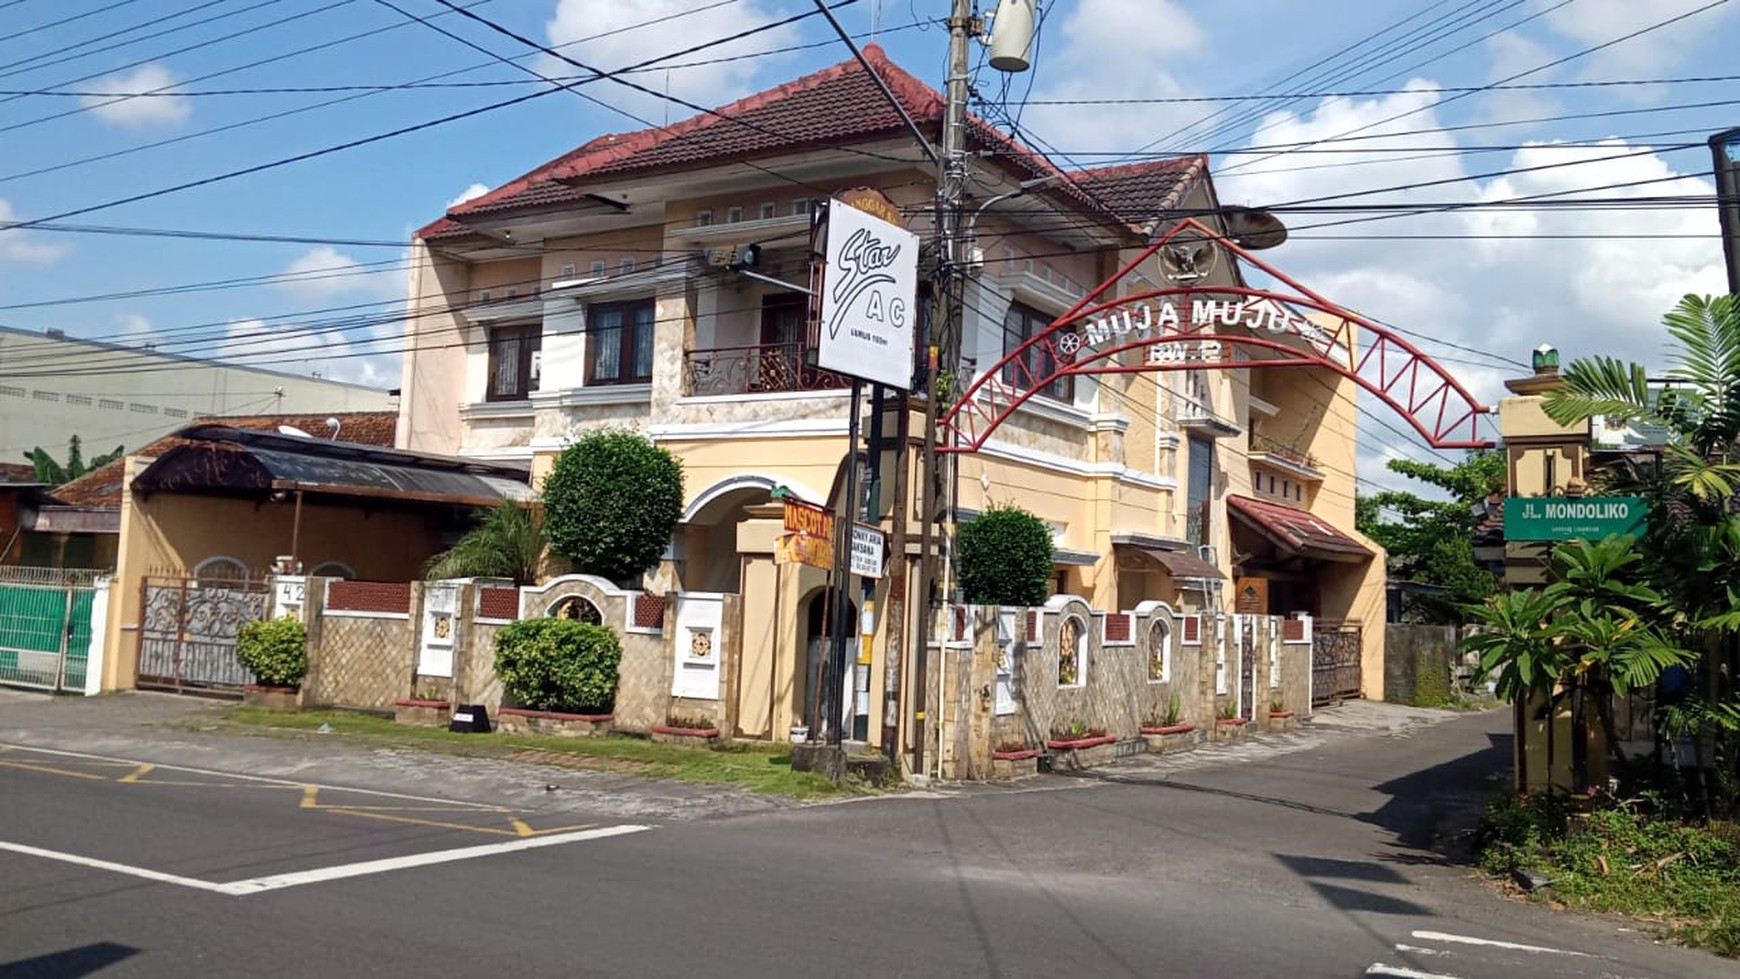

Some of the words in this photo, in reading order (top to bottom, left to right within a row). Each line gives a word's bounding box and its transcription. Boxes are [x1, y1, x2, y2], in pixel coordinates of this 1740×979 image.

[833, 228, 901, 304] Star
[1085, 302, 1179, 346] MUJA
[1192, 299, 1291, 334] MUJU
[784, 502, 823, 535] MASCOT
[1522, 503, 1542, 519] JL.
[1545, 503, 1629, 519] MONDOLIKO
[283, 584, 305, 601] 42
